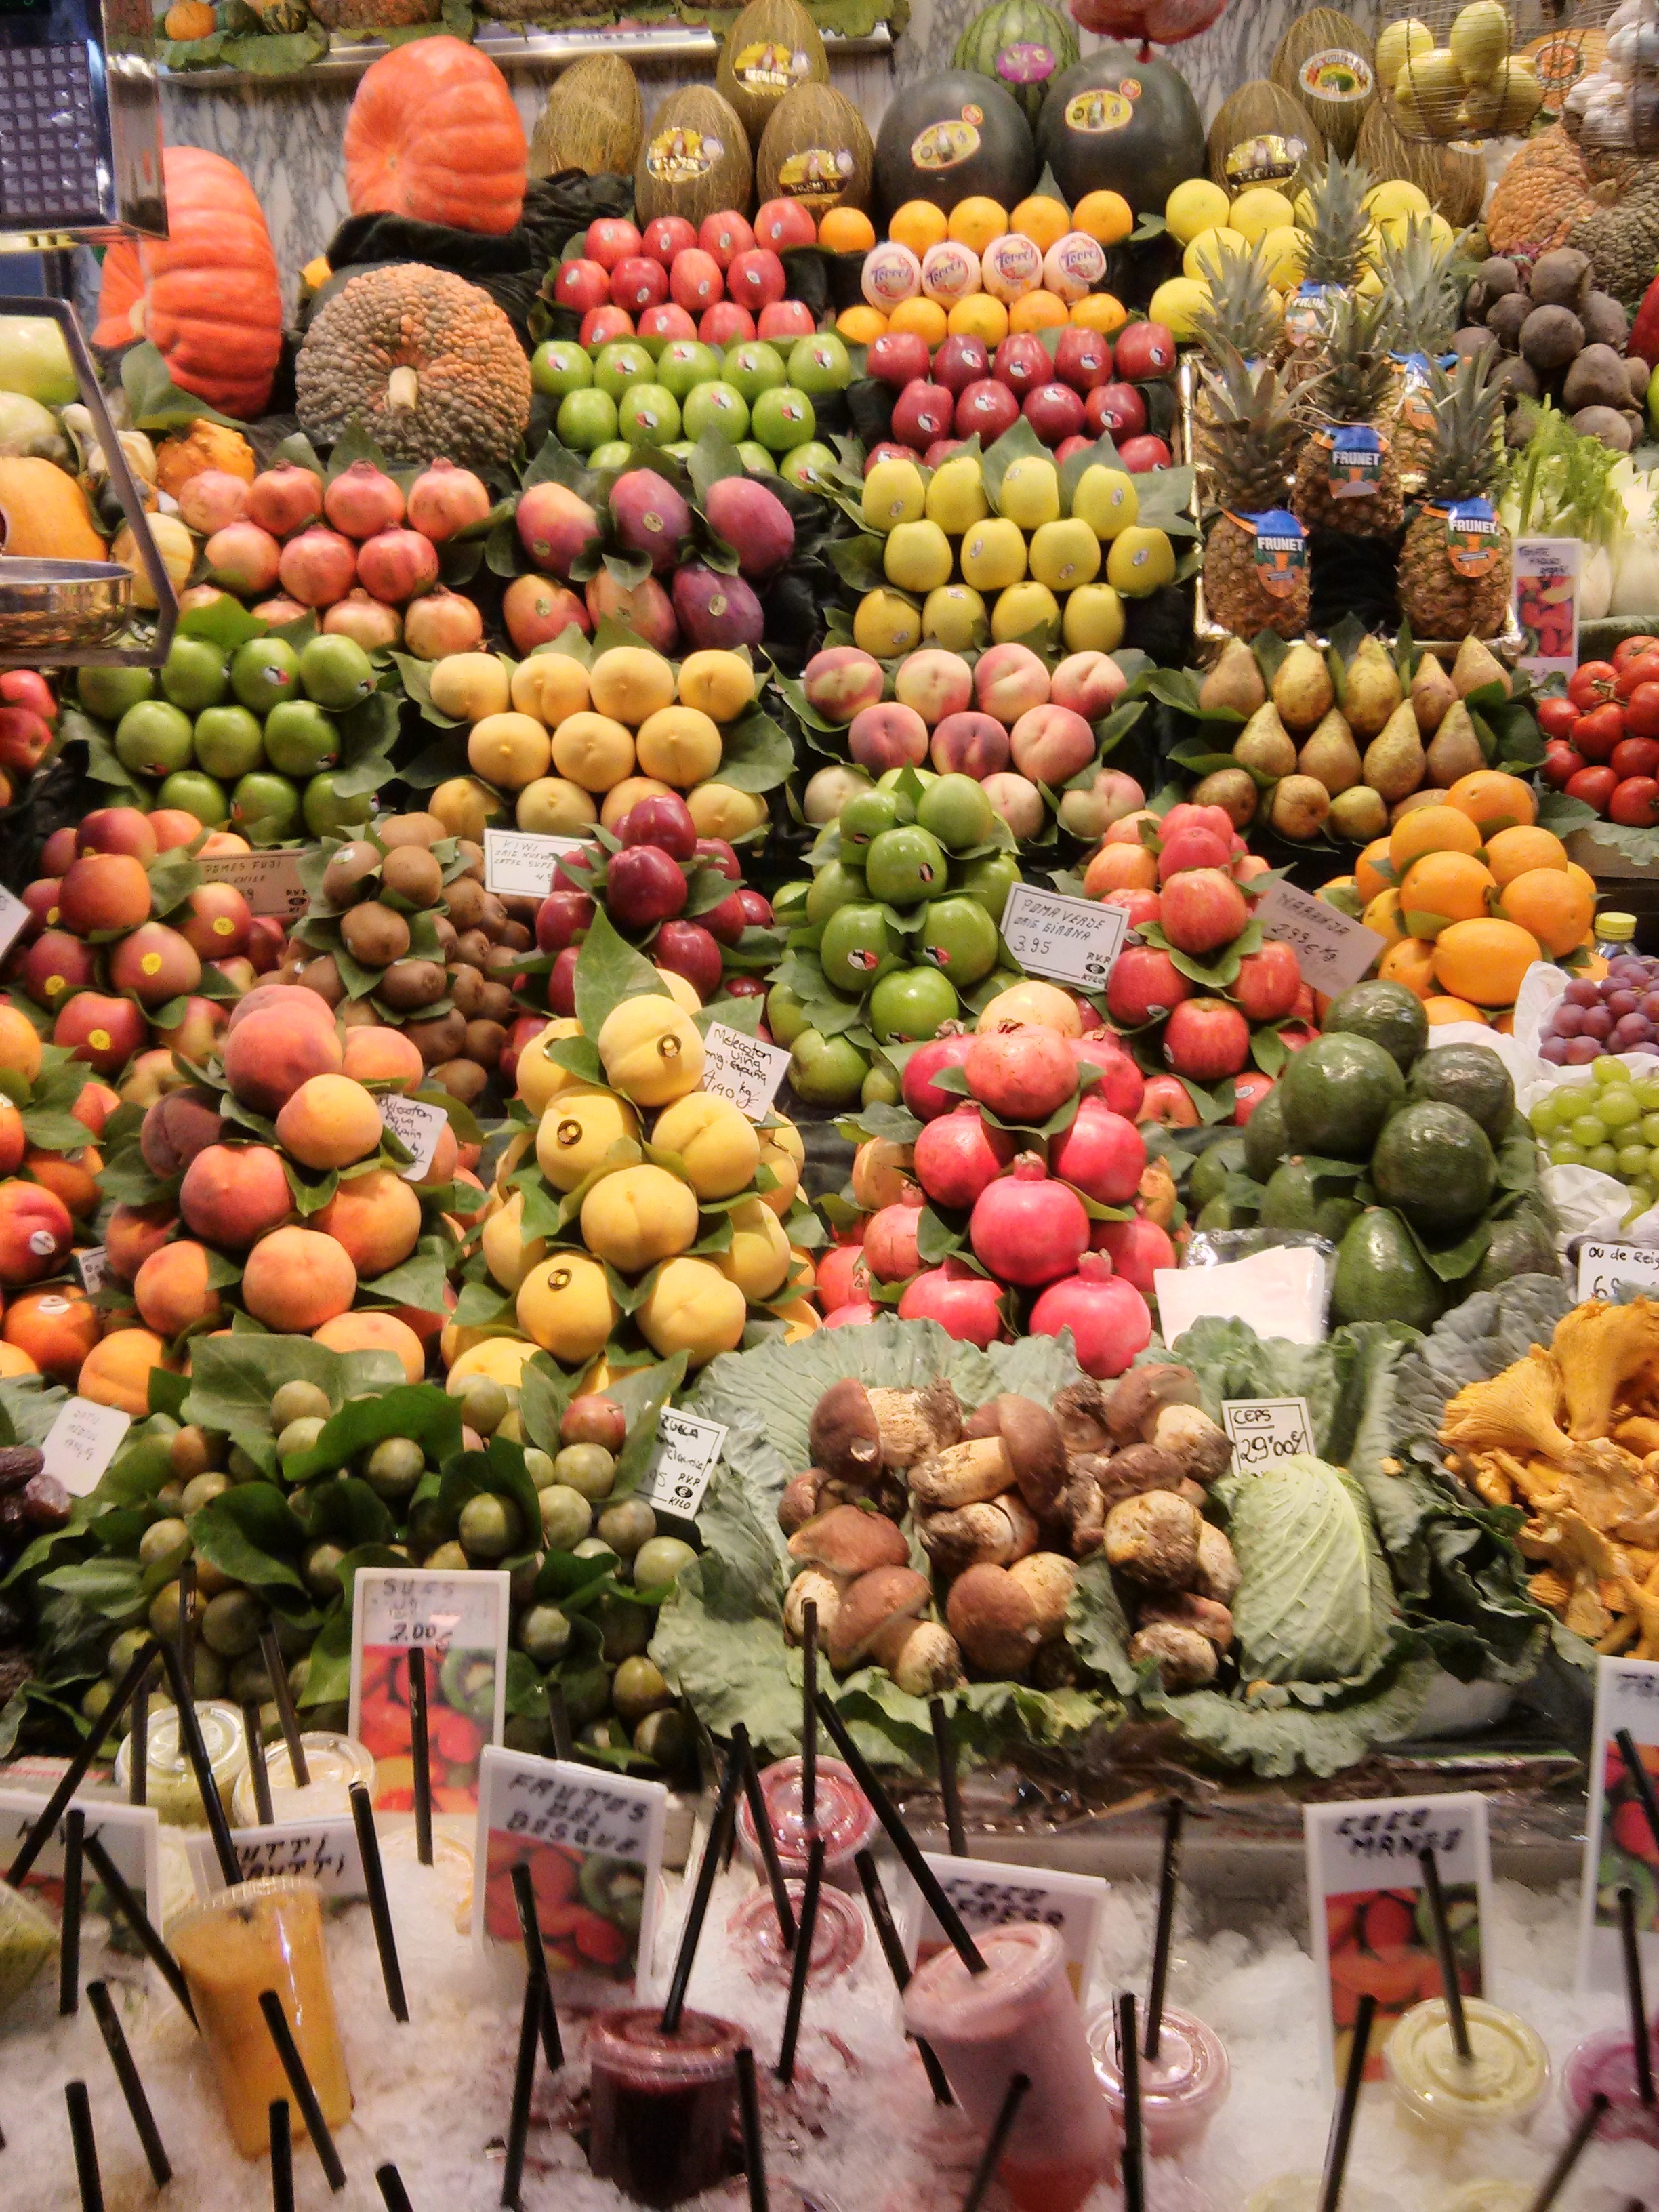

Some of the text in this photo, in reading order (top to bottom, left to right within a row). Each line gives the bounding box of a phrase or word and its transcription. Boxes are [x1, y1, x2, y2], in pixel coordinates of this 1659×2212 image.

[1292, 297, 1326, 309] FRUN
[1332, 451, 1381, 466] FRUNET
[1450, 519, 1498, 534] FRUNET
[1258, 536, 1304, 552] FRUNET
[1021, 899, 1106, 930] POMA VERDE
[1277, 893, 1351, 936] NARANJA
[1610, 1248, 1626, 1261] de
[1233, 1409, 1271, 1424] CEPS
[668, 1496, 691, 1510] KILO
[1336, 1807, 1431, 1835] COCO
[235, 1832, 329, 1862] UTTI
